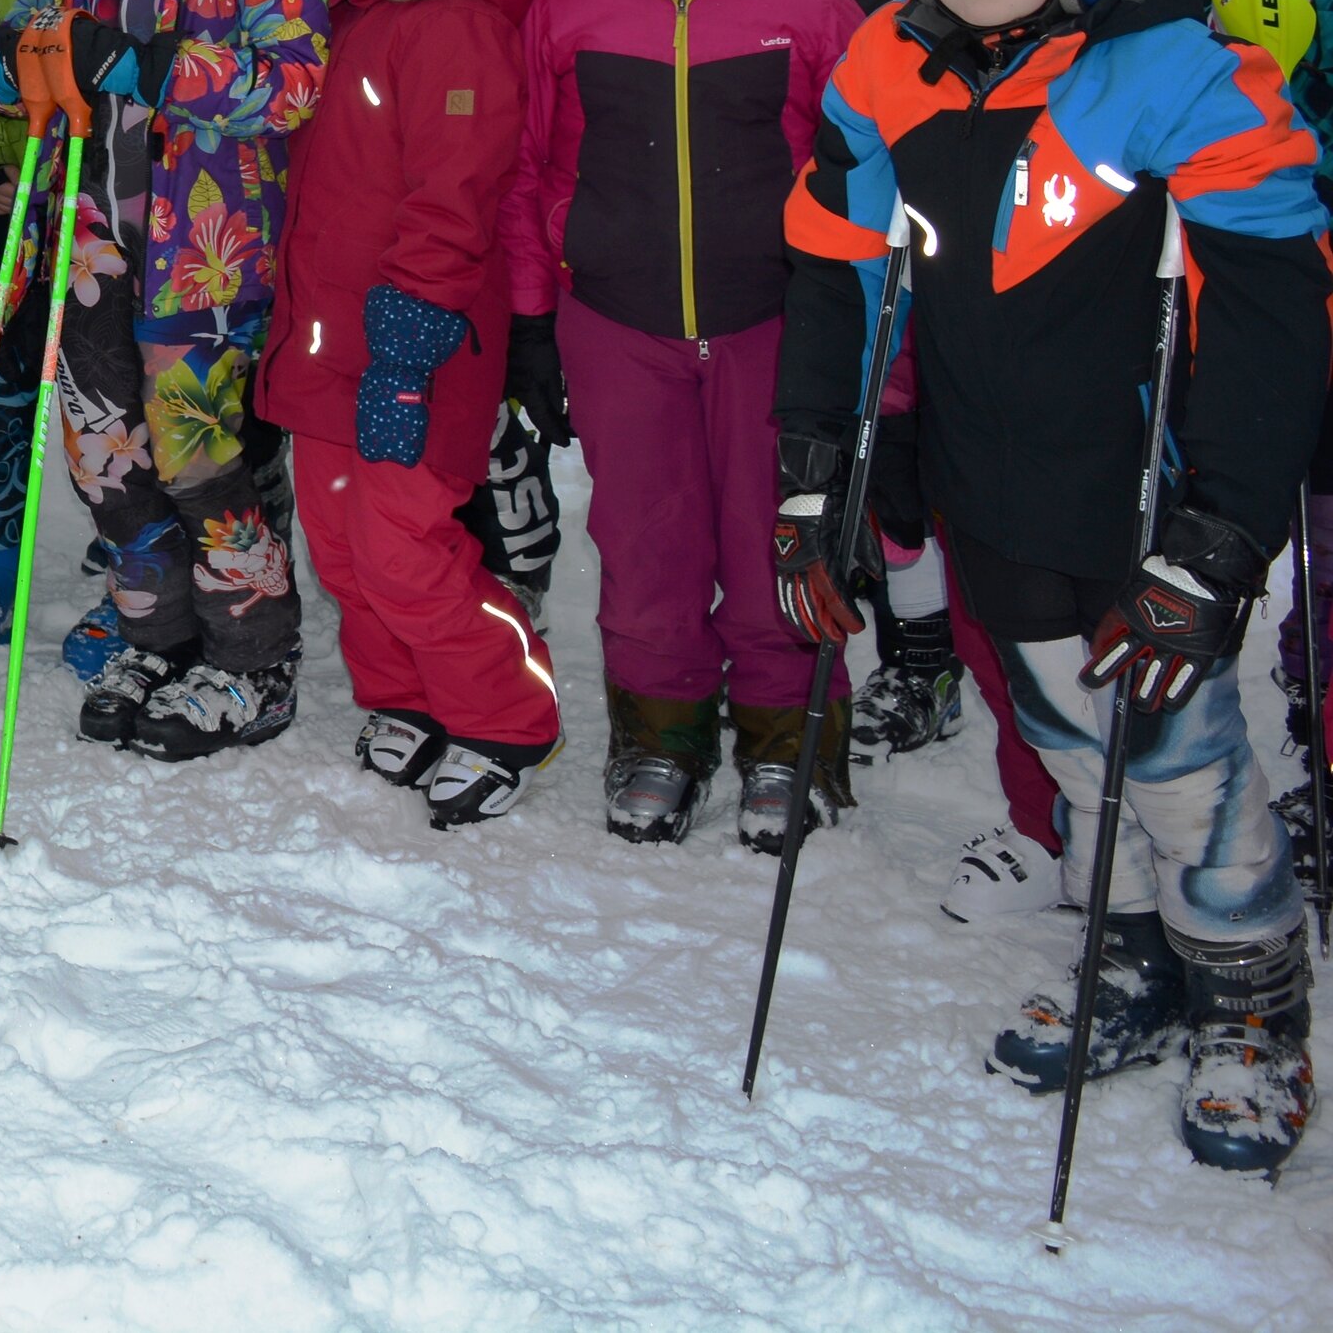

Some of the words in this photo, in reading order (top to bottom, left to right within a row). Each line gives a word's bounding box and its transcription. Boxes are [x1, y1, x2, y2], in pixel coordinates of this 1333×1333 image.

[92, 51, 117, 85] ziener
[859, 420, 872, 459] HEAD
[1139, 468, 1150, 511] HEAD
